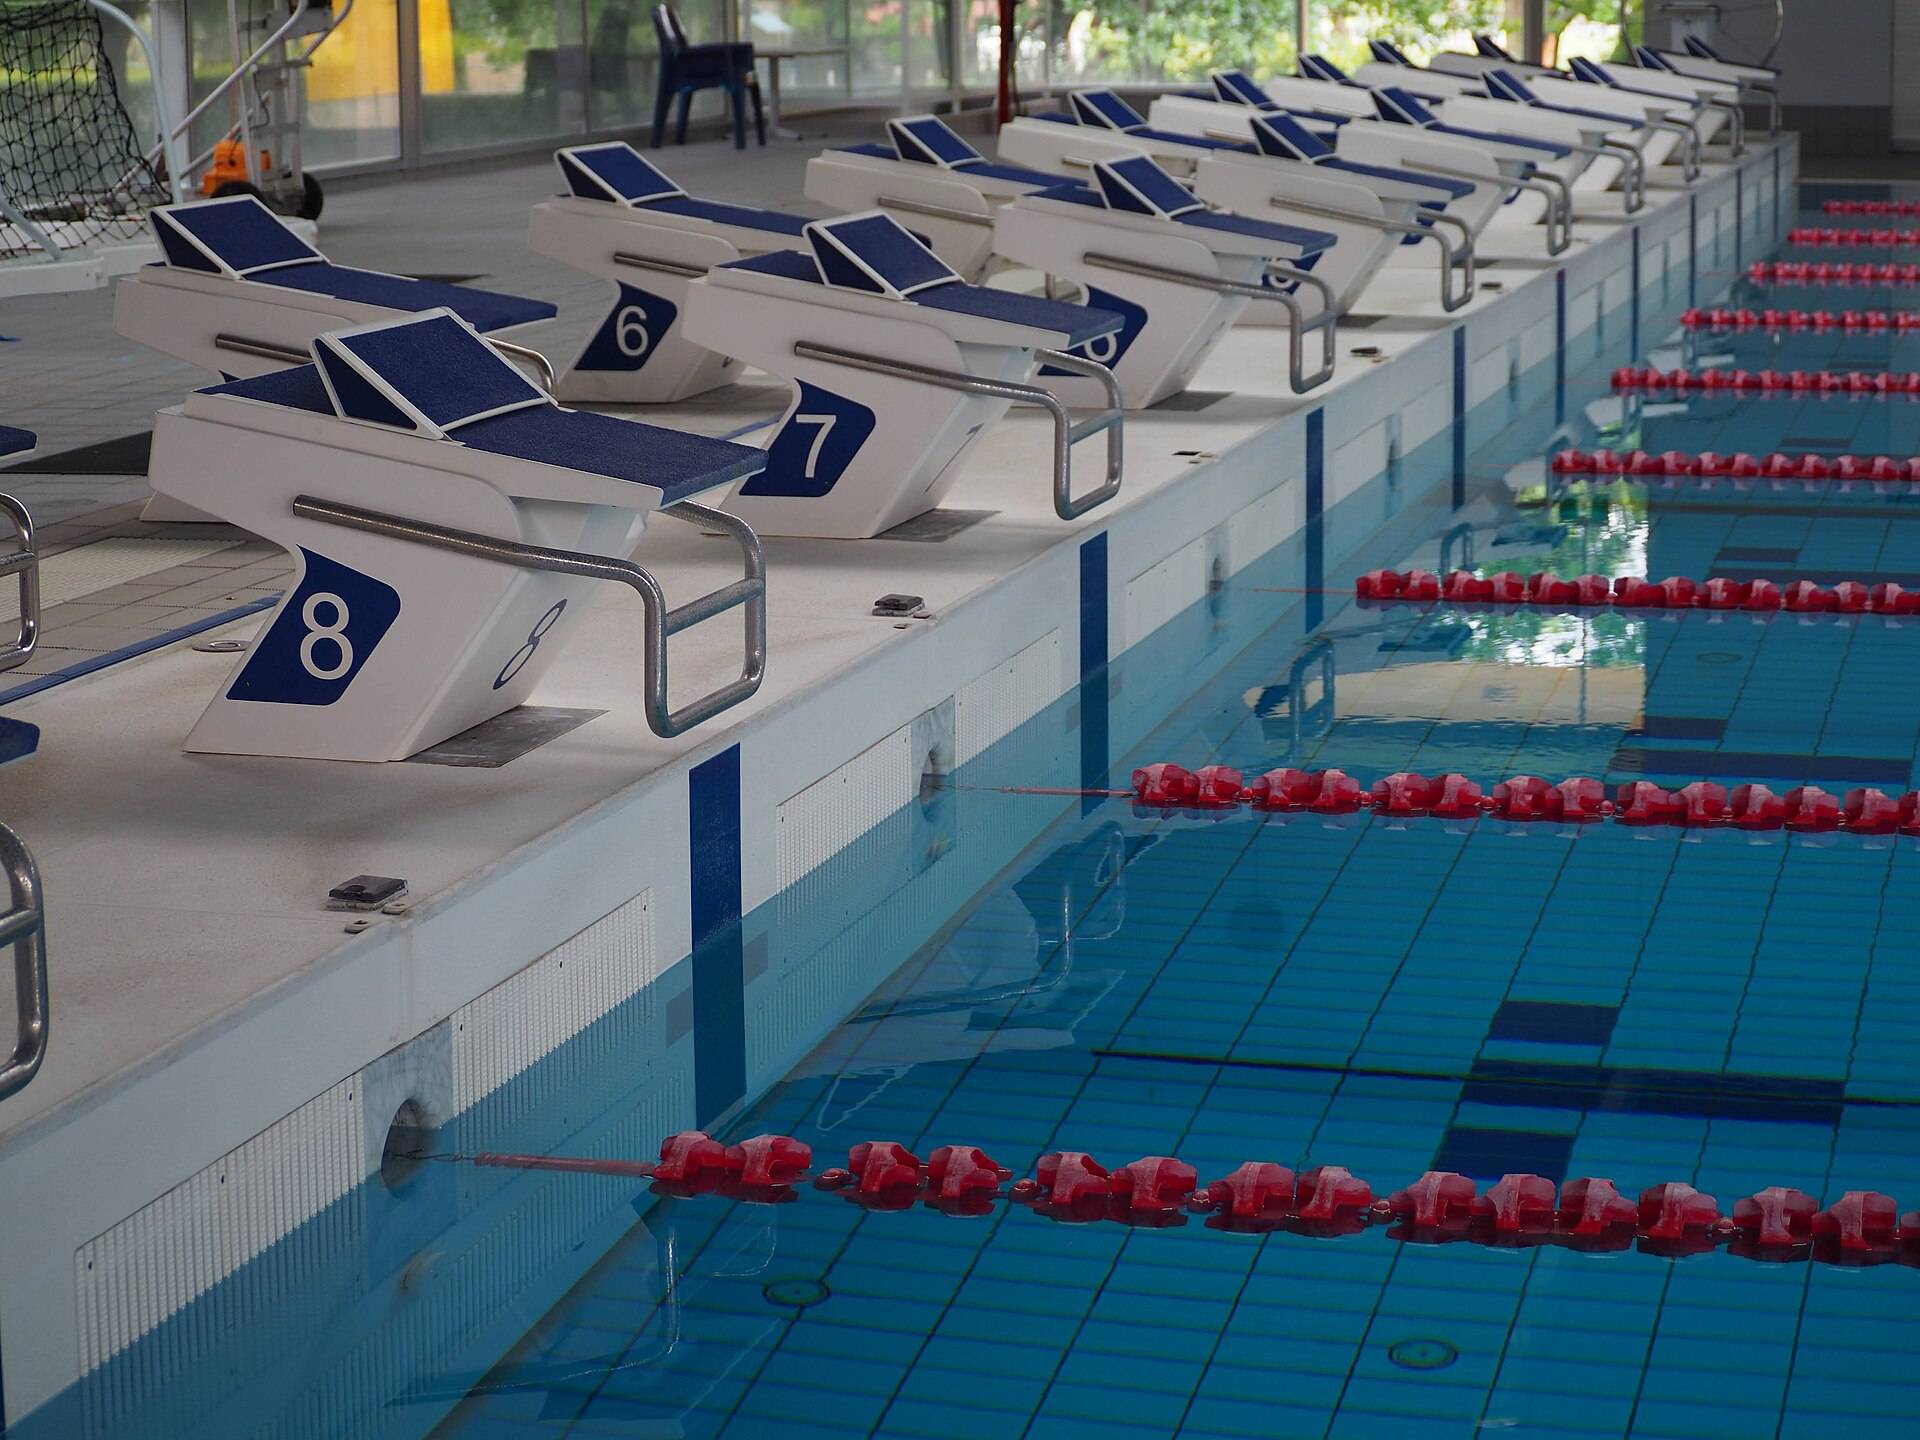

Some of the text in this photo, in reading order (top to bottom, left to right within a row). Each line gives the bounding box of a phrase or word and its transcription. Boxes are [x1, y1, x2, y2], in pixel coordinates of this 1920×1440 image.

[616, 305, 648, 356] 6
[795, 414, 837, 478] 7
[300, 592, 354, 680] 8
[493, 598, 568, 690] 8
